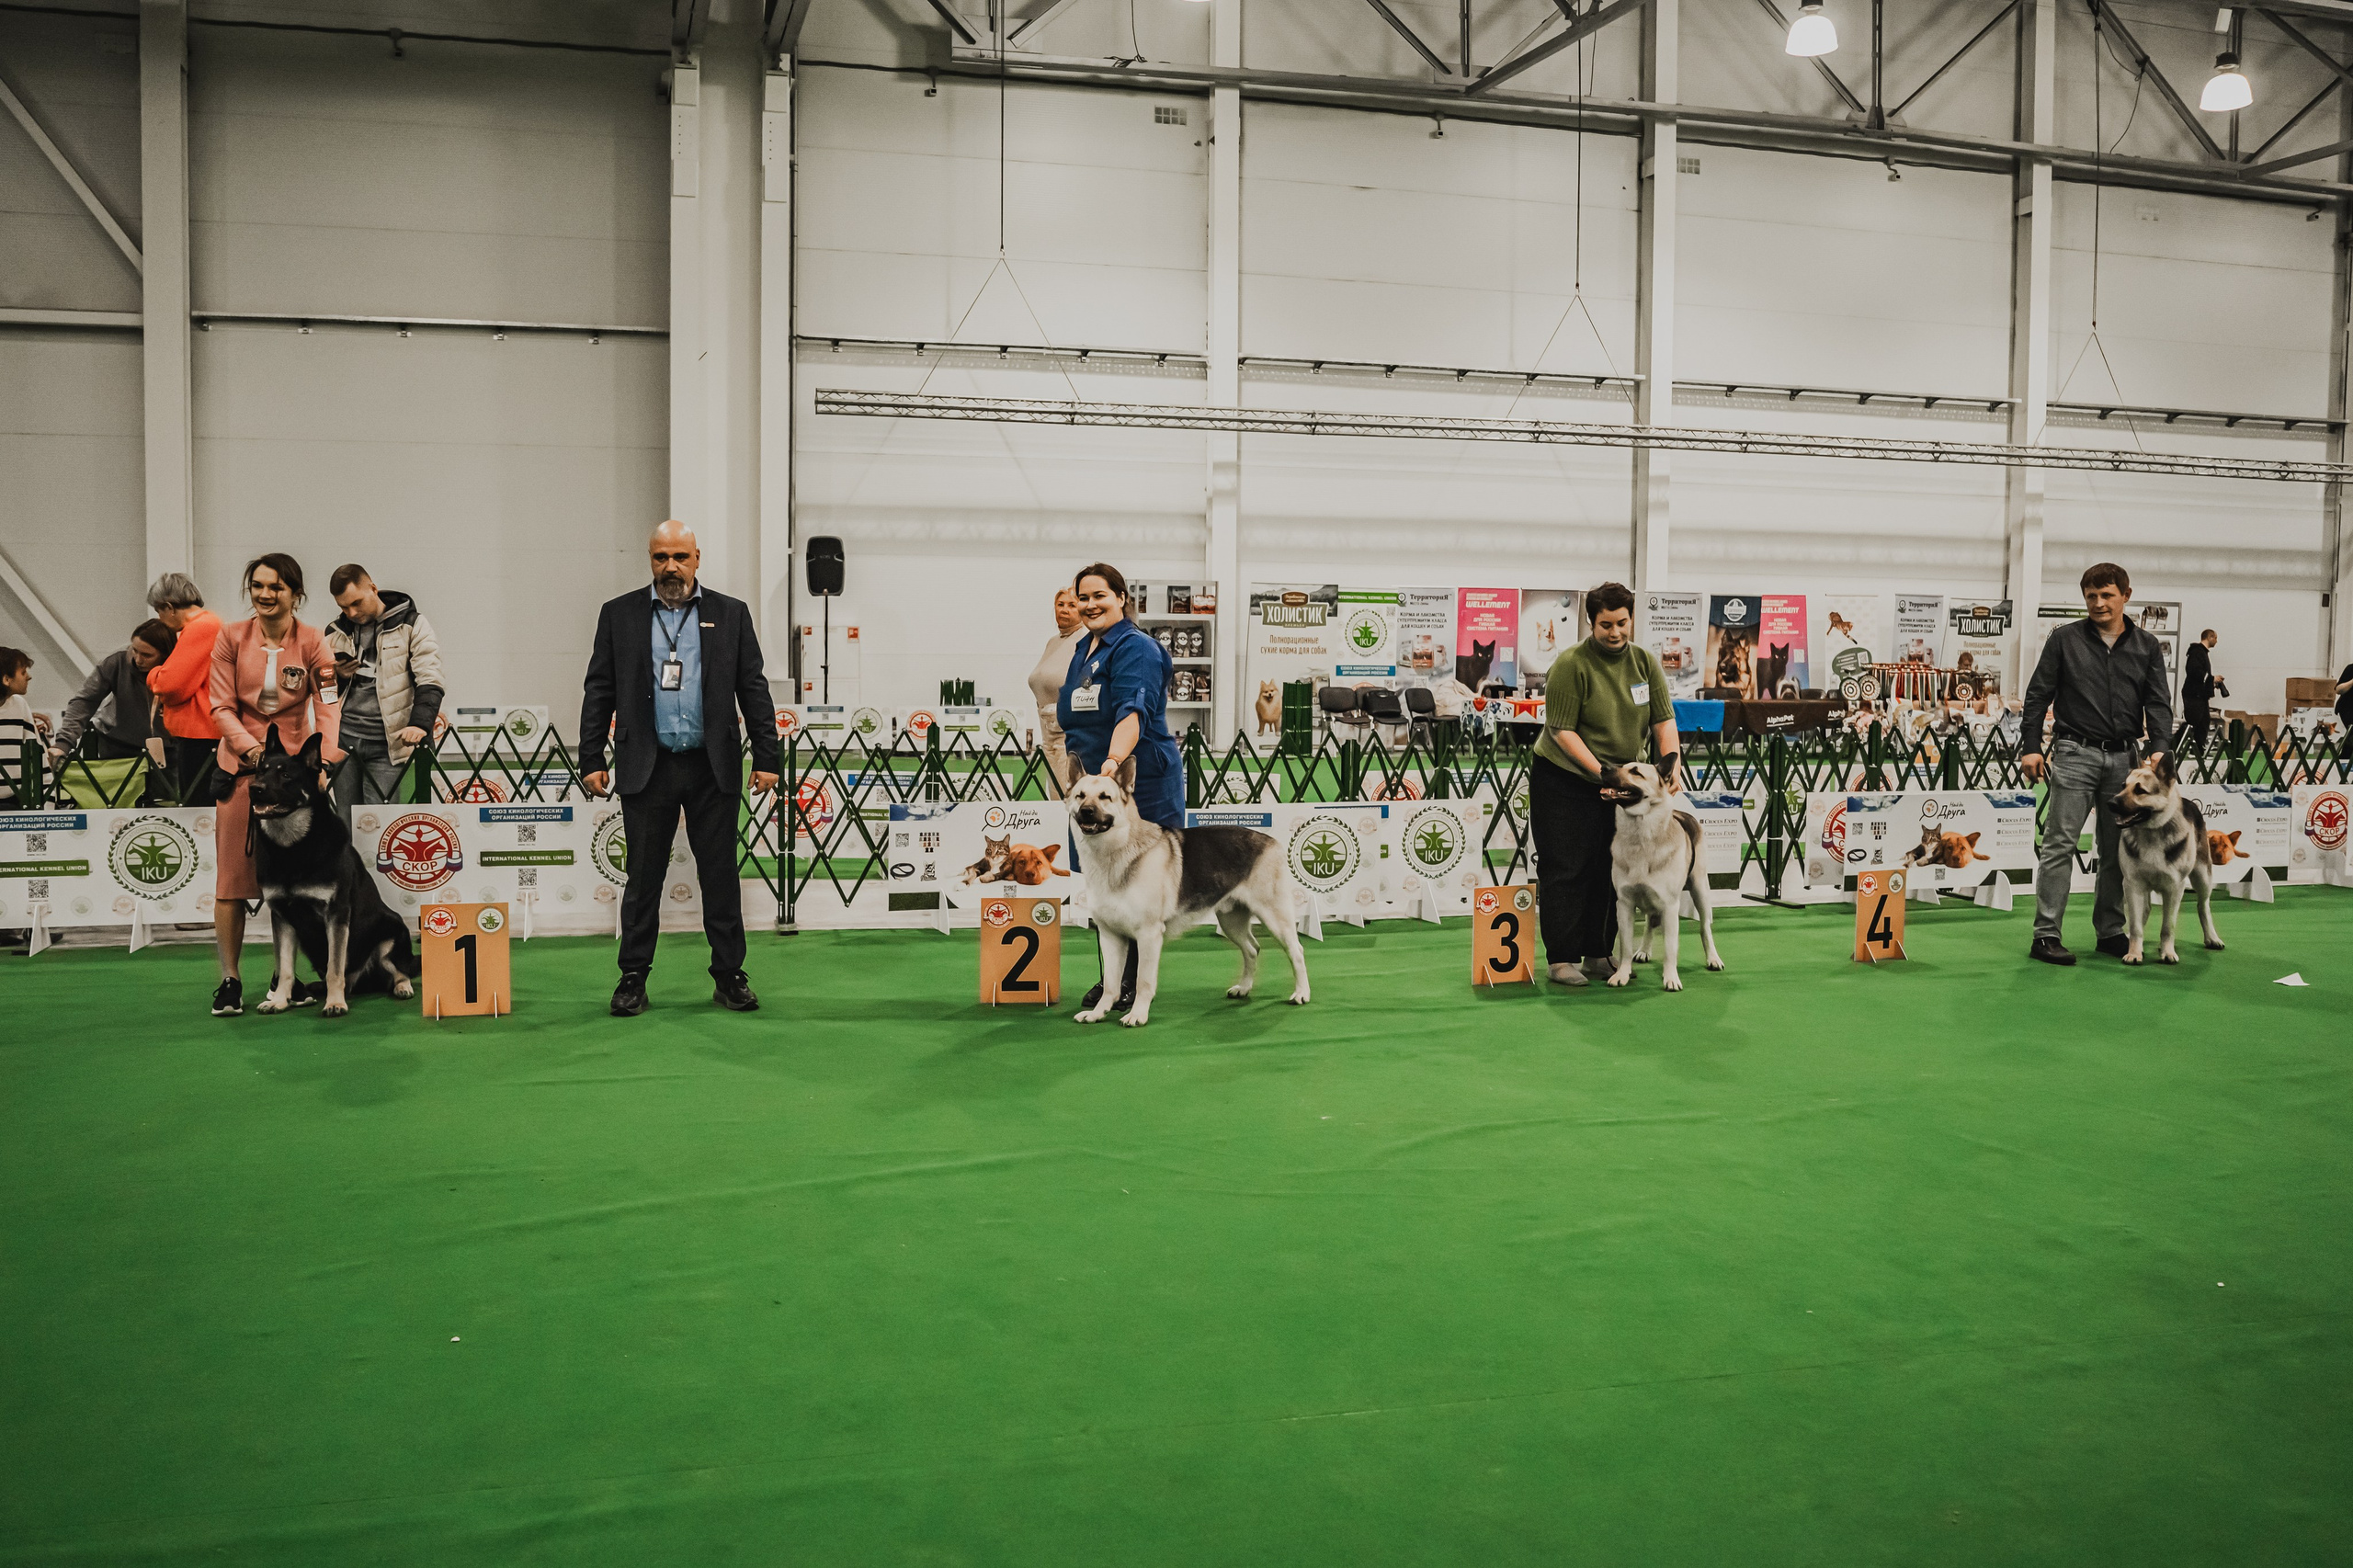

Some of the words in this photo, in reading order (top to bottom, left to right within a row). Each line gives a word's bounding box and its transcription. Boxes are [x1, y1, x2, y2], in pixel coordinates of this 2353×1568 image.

[1267, 606, 1323, 623] ХОЛИСТИК
[1961, 619, 2000, 633] ХОЛИСТИК
[1269, 635, 1319, 644] Полнорационные
[1311, 646, 1327, 654] собак
[1767, 714, 1794, 724] AlphaPet
[1937, 805, 1966, 819] Друга
[2202, 804, 2228, 818] Друга
[1005, 813, 1040, 830] Друга
[1426, 850, 1443, 861] IKU
[403, 861, 438, 871] СКОР
[1313, 862, 1335, 875] IKU
[142, 867, 167, 881] IKU
[1867, 894, 1893, 949] 4
[1489, 912, 1519, 972] 3
[1001, 926, 1040, 991] 2
[455, 935, 477, 1004] 1
